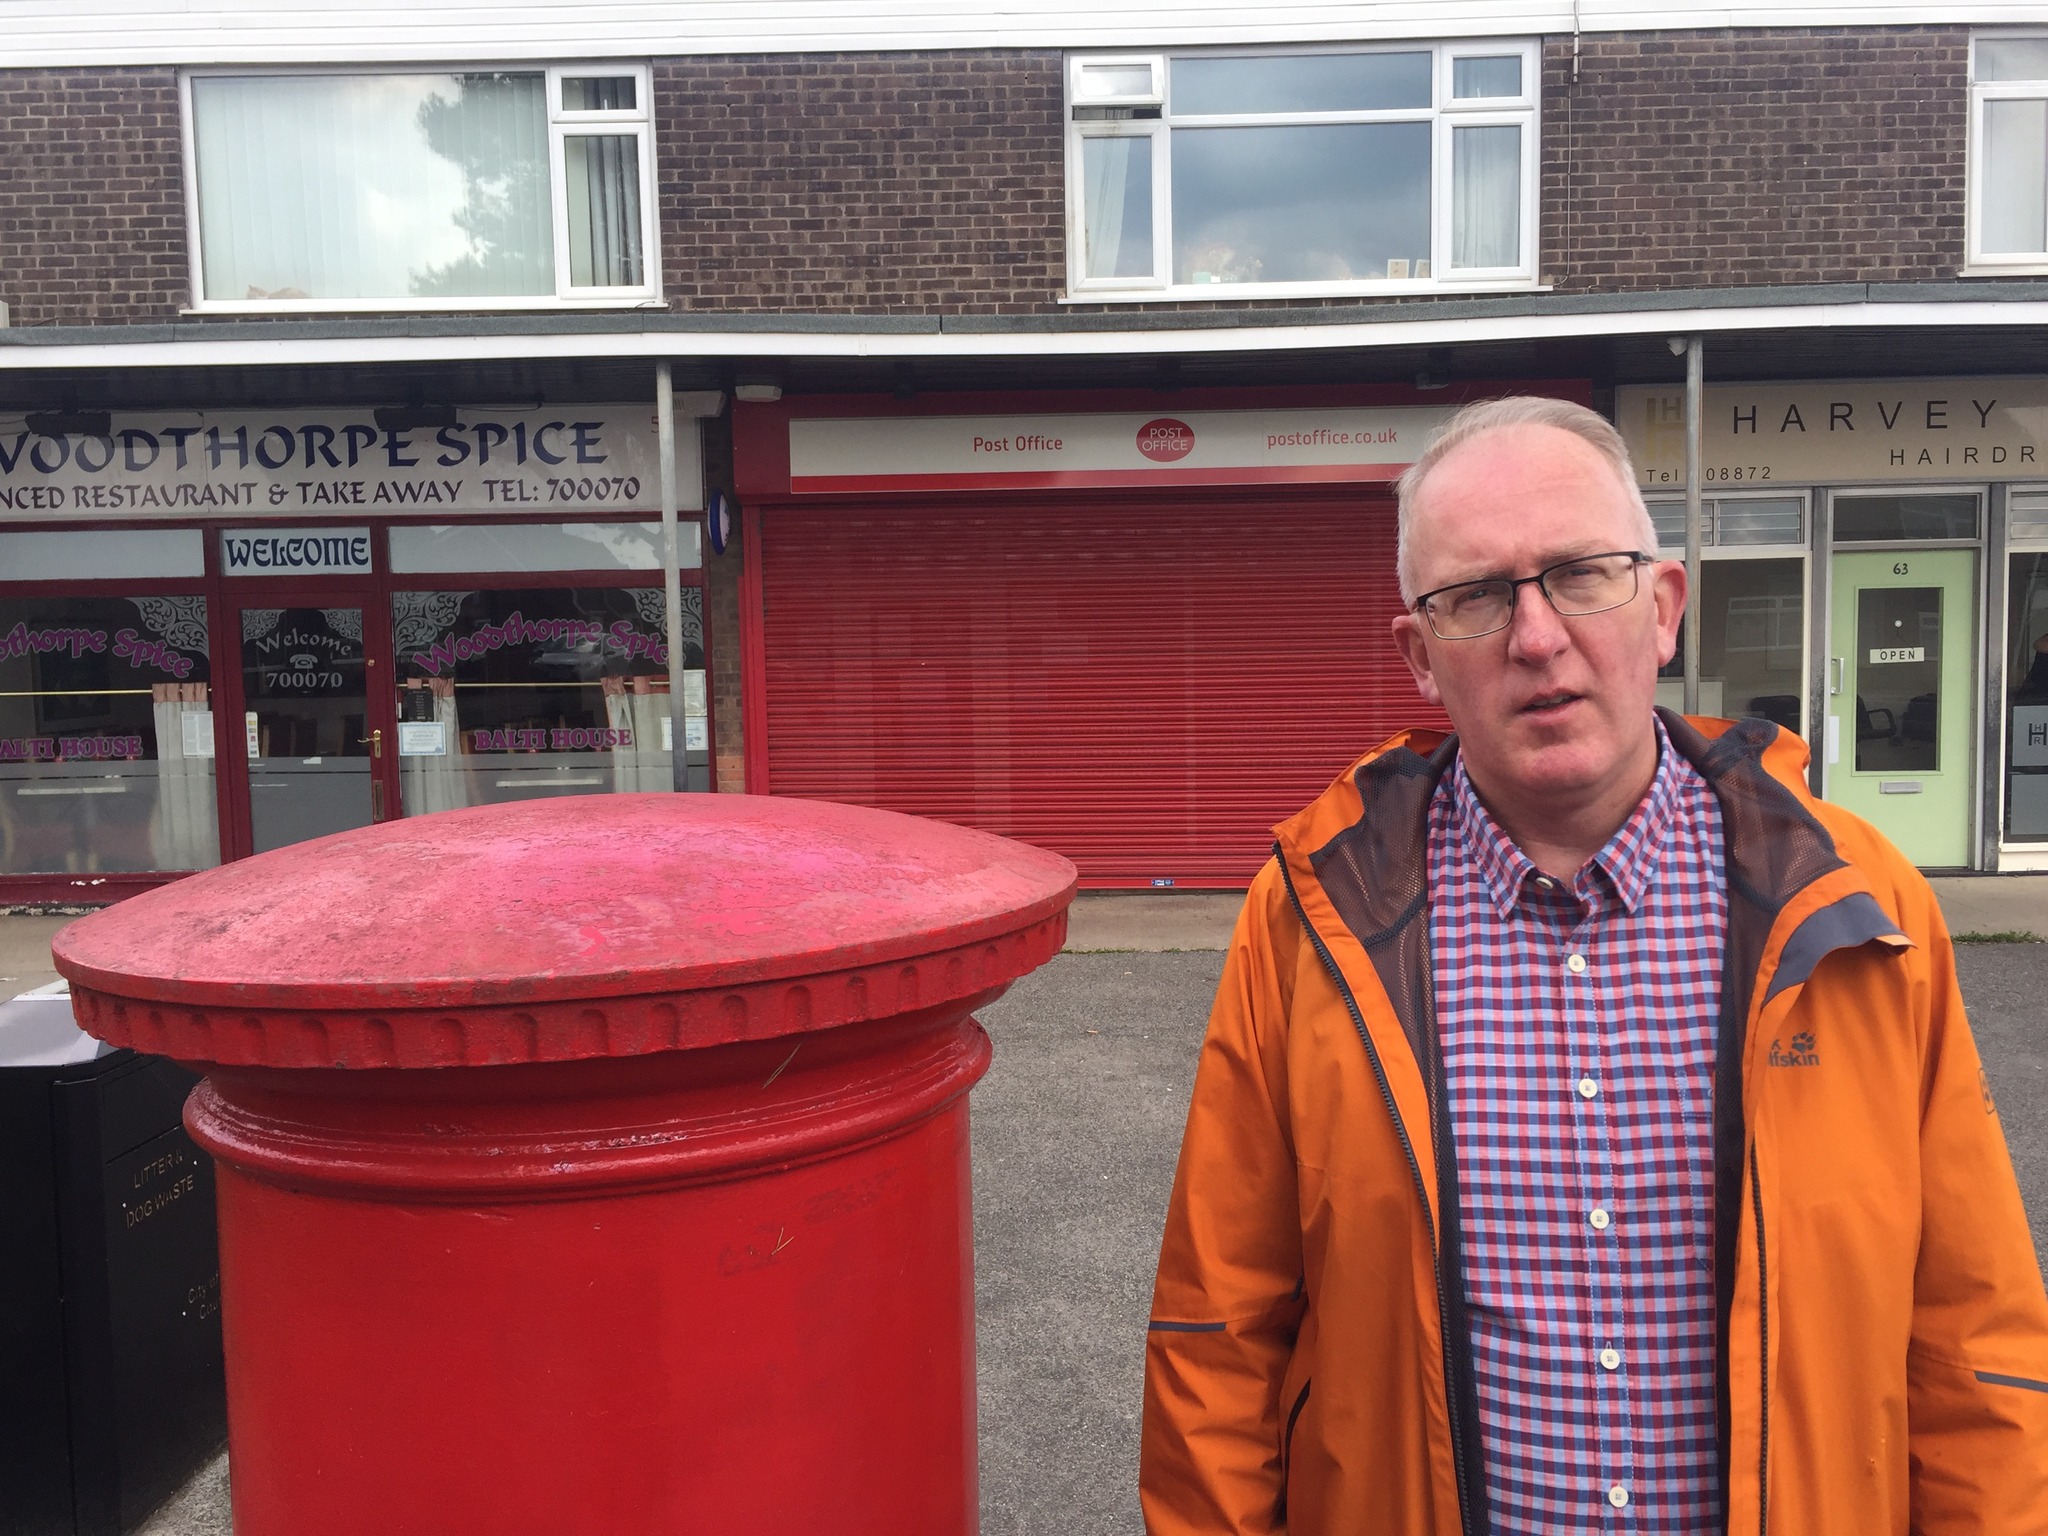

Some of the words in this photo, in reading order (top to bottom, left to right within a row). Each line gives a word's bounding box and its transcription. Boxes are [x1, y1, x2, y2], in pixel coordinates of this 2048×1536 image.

[1732, 399, 1998, 434] HARVEY
[436, 421, 609, 467] SPICE
[973, 436, 1010, 452] Post
[1015, 435, 1063, 451] Office
[1149, 427, 1184, 439] POST
[1267, 428, 1398, 450] postoffice.co.uk
[1141, 439, 1189, 452] OFFICE
[1889, 445, 2036, 466] HAIRDR
[1646, 468, 1679, 482] Tel
[72, 481, 259, 509] RESTAURANT
[268, 483, 290, 505] &
[296, 480, 366, 505] TAKE
[371, 479, 464, 505] AWAY
[482, 478, 540, 503] TEL:
[547, 475, 641, 503] 700070
[224, 537, 369, 567] WELCOME
[1893, 563, 1909, 575] 63
[255, 627, 352, 656] Welcome
[413, 610, 602, 676] Woodthorpe
[607, 619, 686, 670] Spic
[112, 628, 194, 678] Spice
[1879, 650, 1916, 661] OPEN
[266, 672, 343, 688] 700070
[59, 736, 144, 758] HOUSE
[474, 728, 547, 750] BALTI
[552, 728, 633, 750] HOUSE
[133, 1153, 174, 1189] LITTER
[126, 1199, 153, 1229] DOG
[154, 1174, 195, 1211] WASTE
